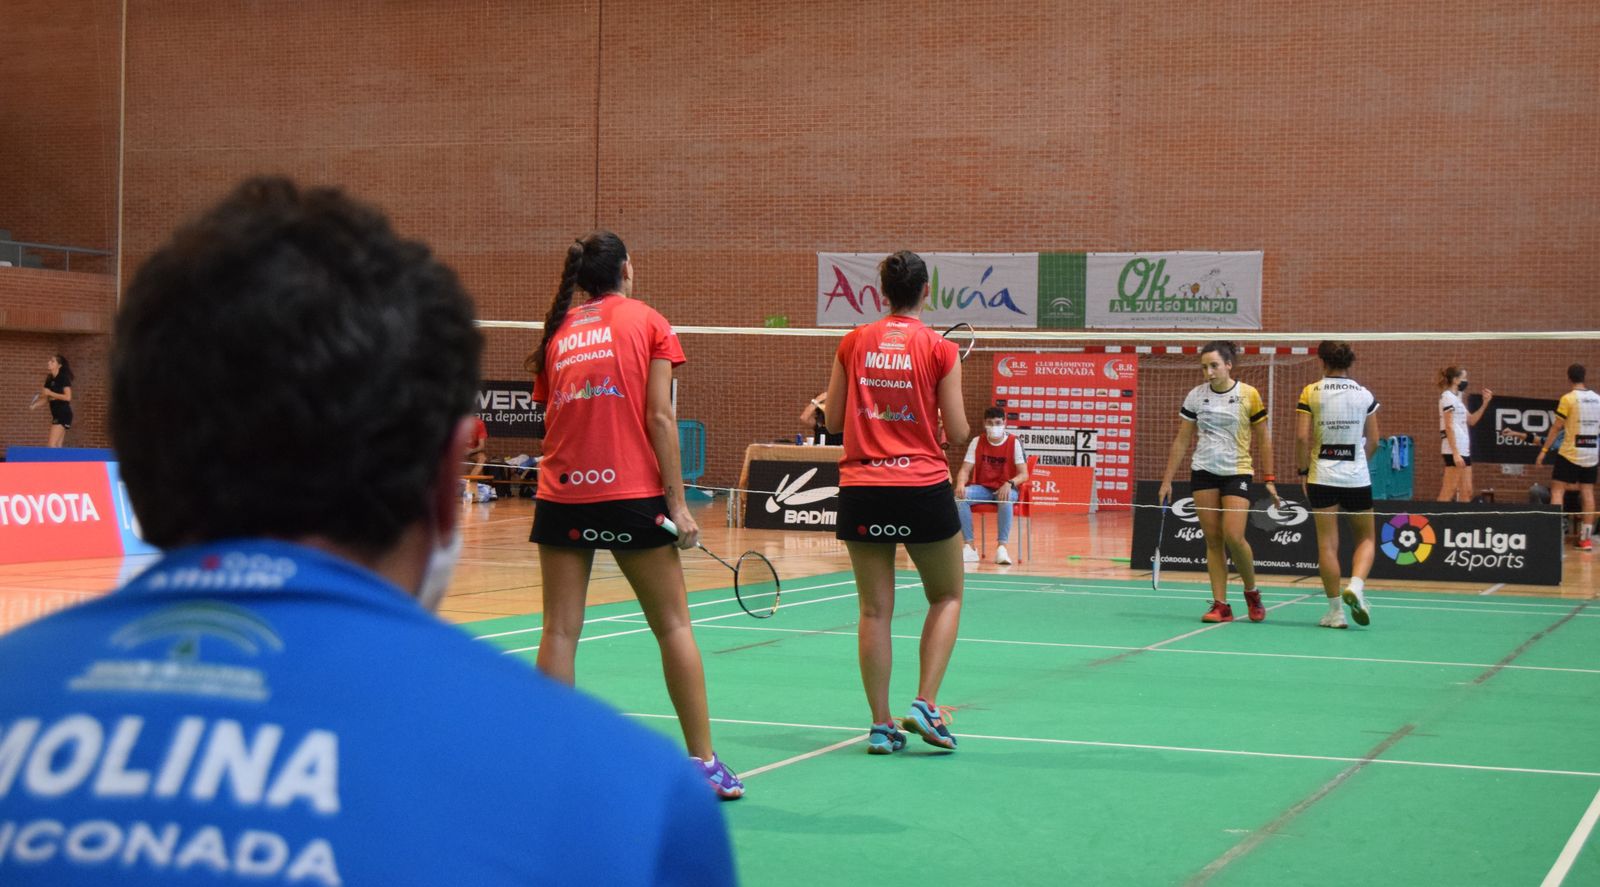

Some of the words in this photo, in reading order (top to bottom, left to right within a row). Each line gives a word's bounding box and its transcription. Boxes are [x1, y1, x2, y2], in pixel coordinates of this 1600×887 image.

[1118, 257, 1176, 300] Ok
[1112, 301, 1131, 312] AL
[1135, 301, 1181, 312] JUEGO
[1185, 301, 1235, 312] LIMPIO
[558, 326, 613, 356] MOLINA
[556, 349, 614, 371] RINCONADA
[865, 351, 912, 371] MOLINA
[1035, 366, 1095, 376] RINCONADA
[860, 377, 913, 389] RINCONADA
[1031, 434, 1076, 446] RINCONADA
[1082, 432, 1092, 449] 2
[1042, 455, 1075, 466] FERNANDO
[0, 493, 101, 525] TOYOTA
[1443, 527, 1526, 554] LaLiga
[1444, 550, 1524, 571] 4Sports
